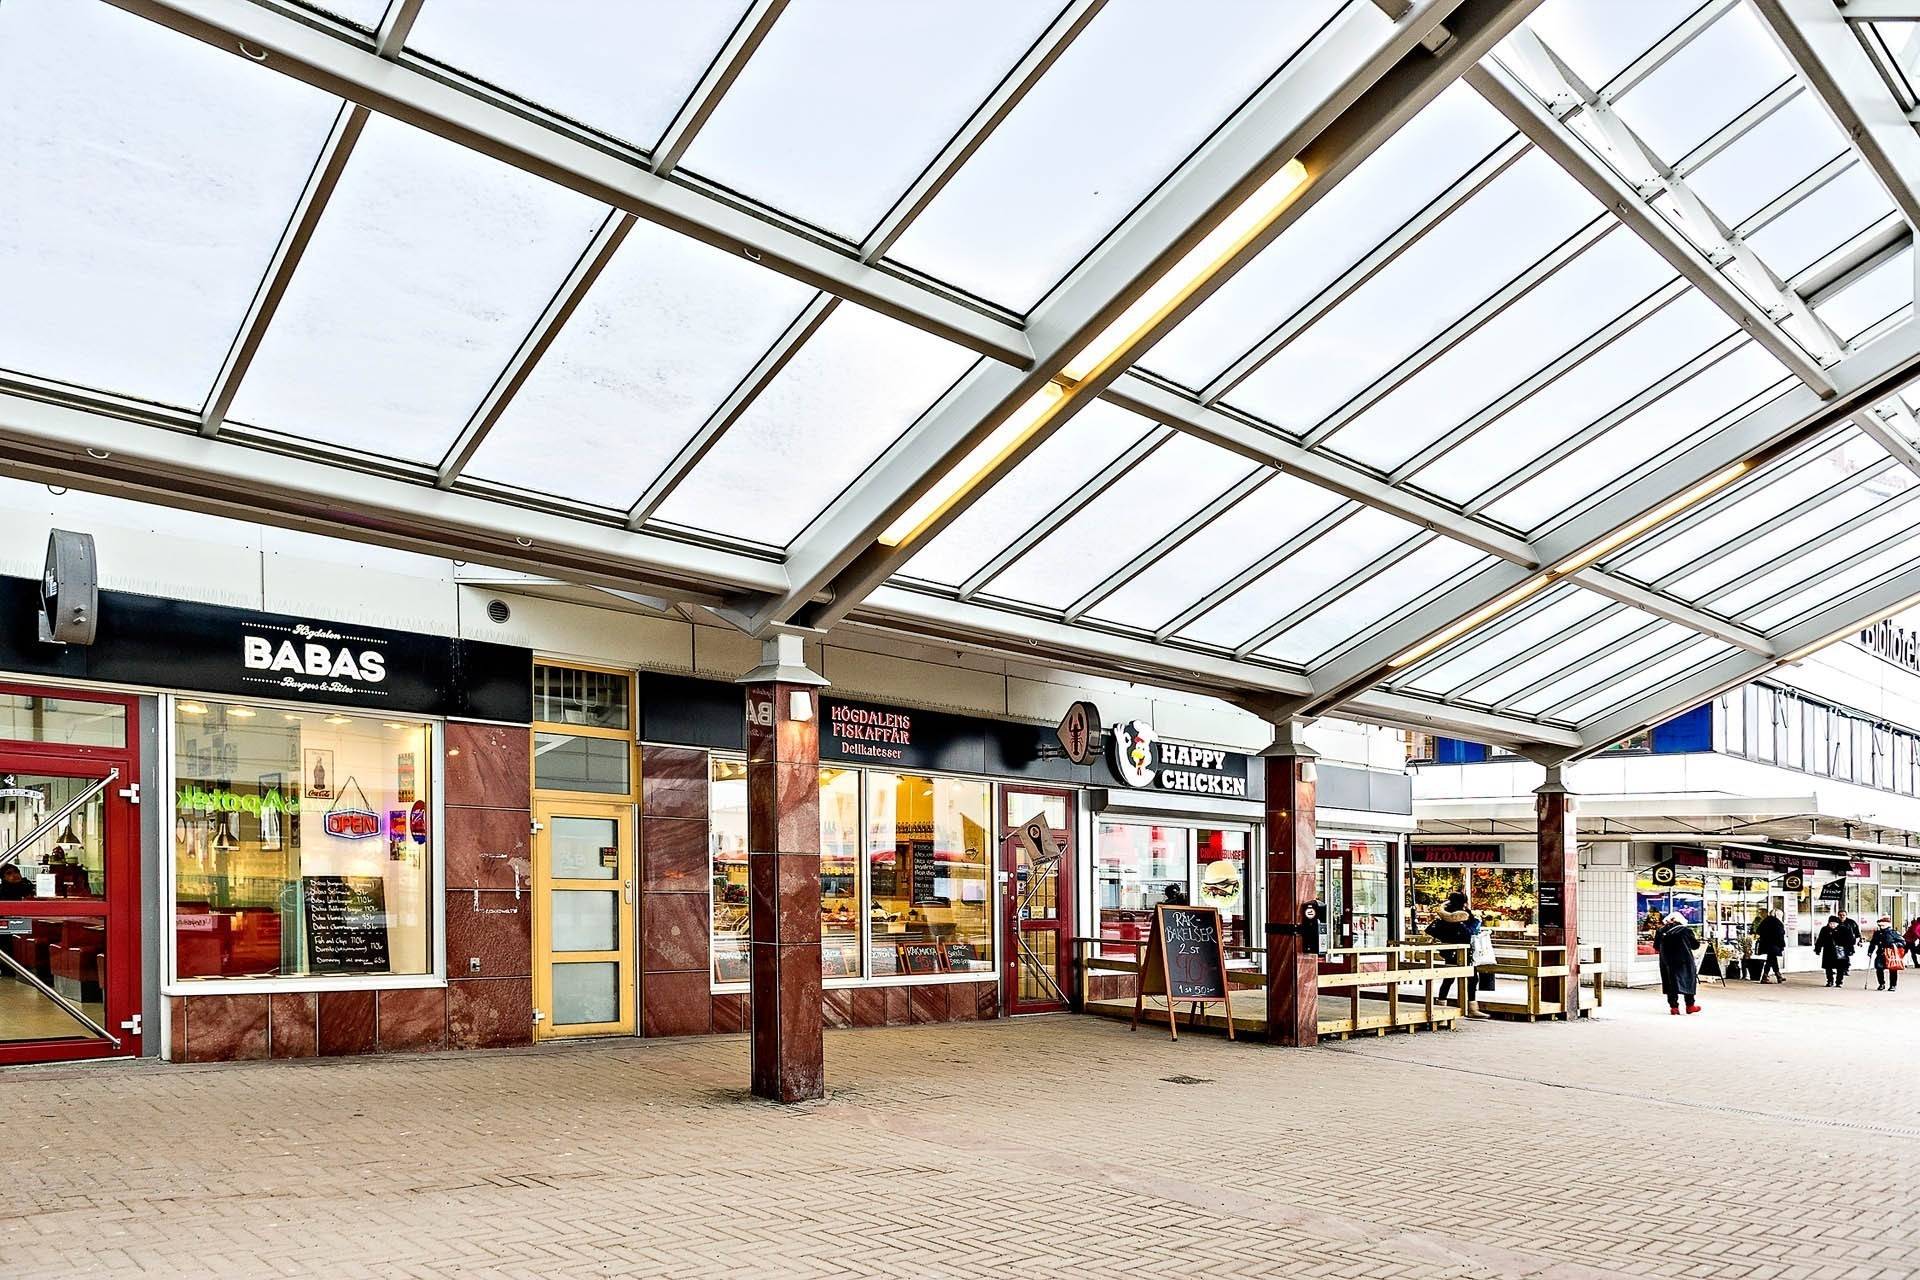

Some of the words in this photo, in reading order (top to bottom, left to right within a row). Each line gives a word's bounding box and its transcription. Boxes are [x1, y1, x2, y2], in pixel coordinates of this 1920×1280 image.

[244, 635, 386, 683] BABAS
[280, 676, 320, 692] Burgers
[320, 682, 329, 691] &
[328, 681, 354, 694] Bites
[831, 705, 910, 729] HÖGDALENS
[832, 721, 910, 745] FISKAFFÄR
[841, 741, 902, 759] Delikatesser
[1161, 743, 1226, 770] HAPPY
[1161, 769, 1246, 796] CHICKEN
[329, 815, 376, 834] OPEN
[1425, 851, 1495, 862] BLOMMOR
[1165, 926, 1217, 943] BAKELSER
[1179, 943, 1189, 954] 2
